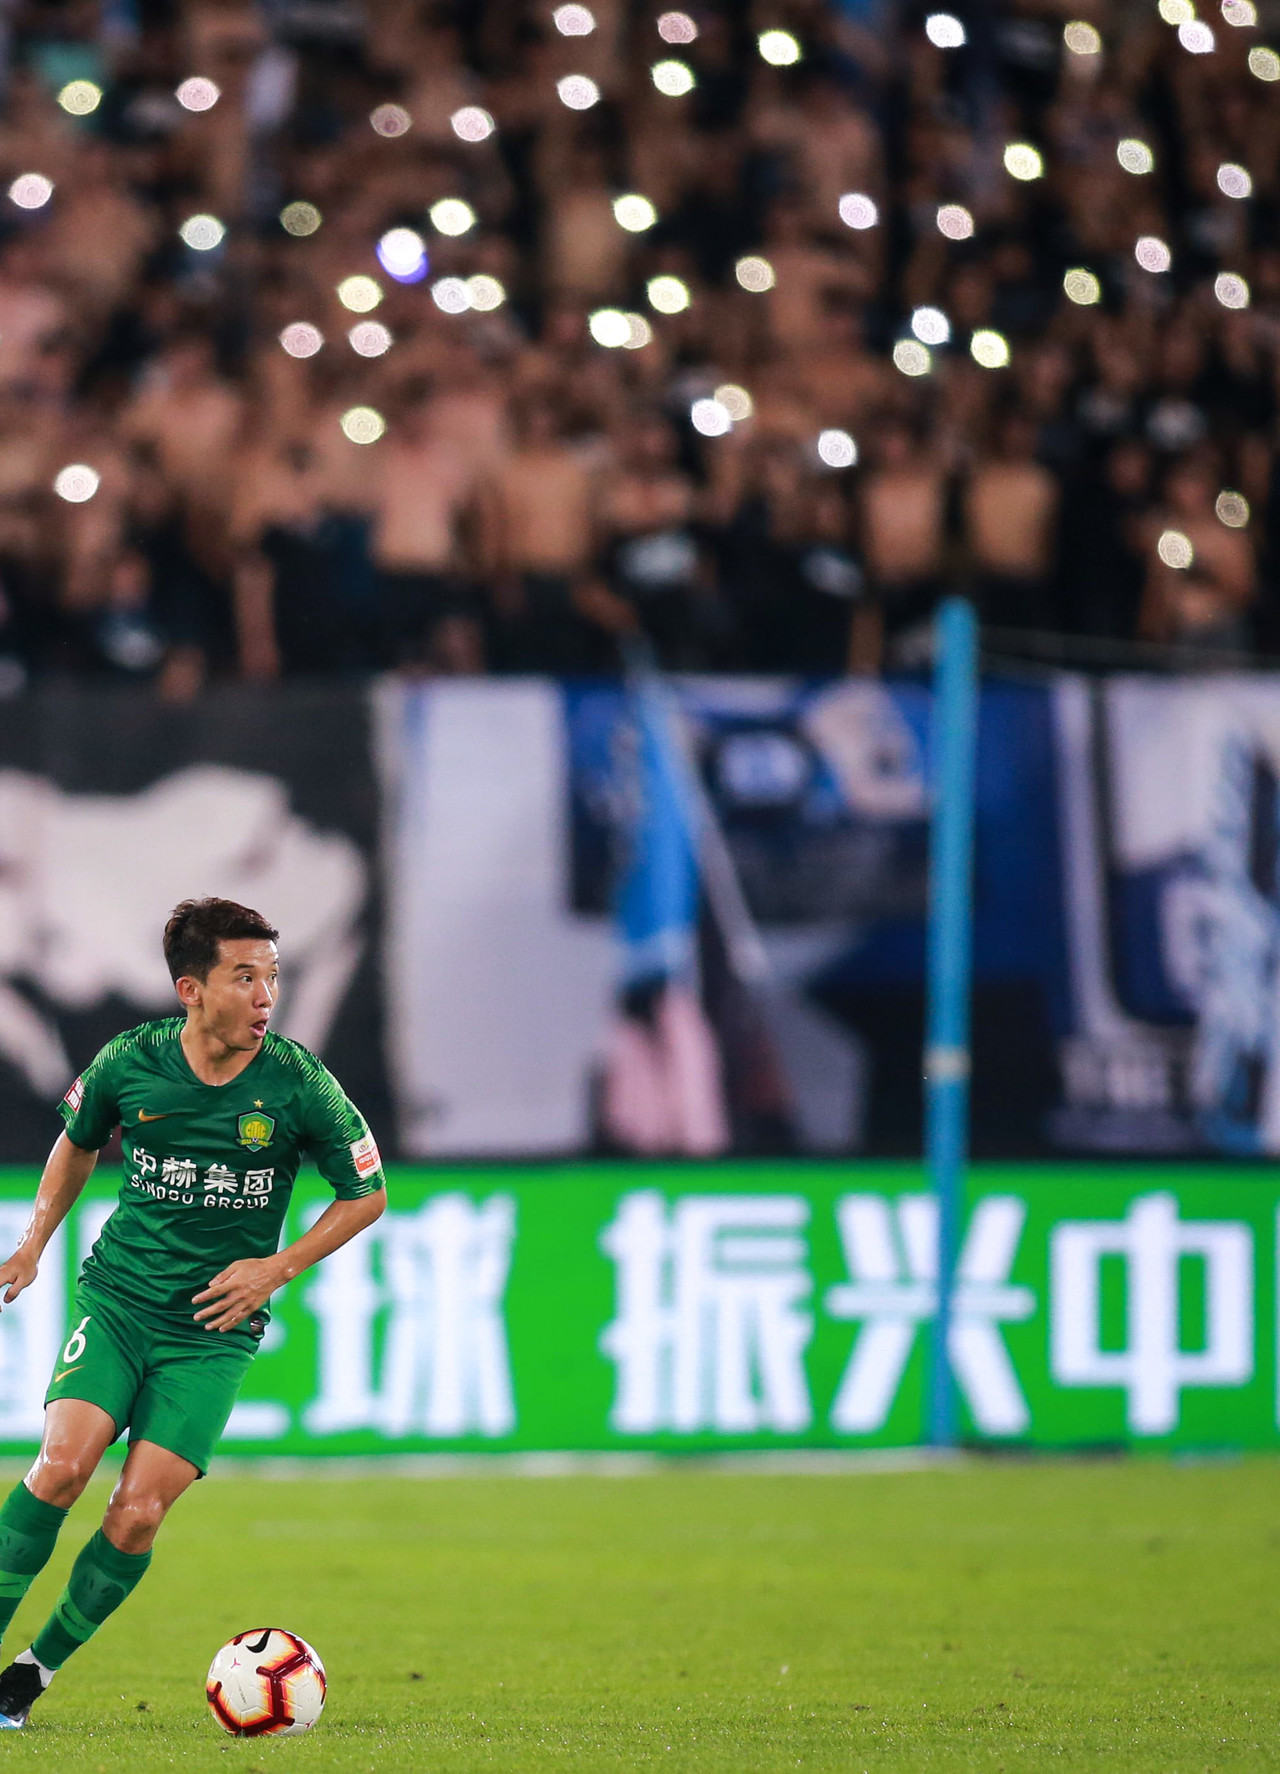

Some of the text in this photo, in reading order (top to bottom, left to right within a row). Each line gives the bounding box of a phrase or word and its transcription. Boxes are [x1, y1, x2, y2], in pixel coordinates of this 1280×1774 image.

[133, 1148, 275, 1196] 中赫集团
[204, 1194, 269, 1209] GROUP
[599, 1190, 1280, 1436] 振兴中
[62, 1316, 92, 1364] 6
